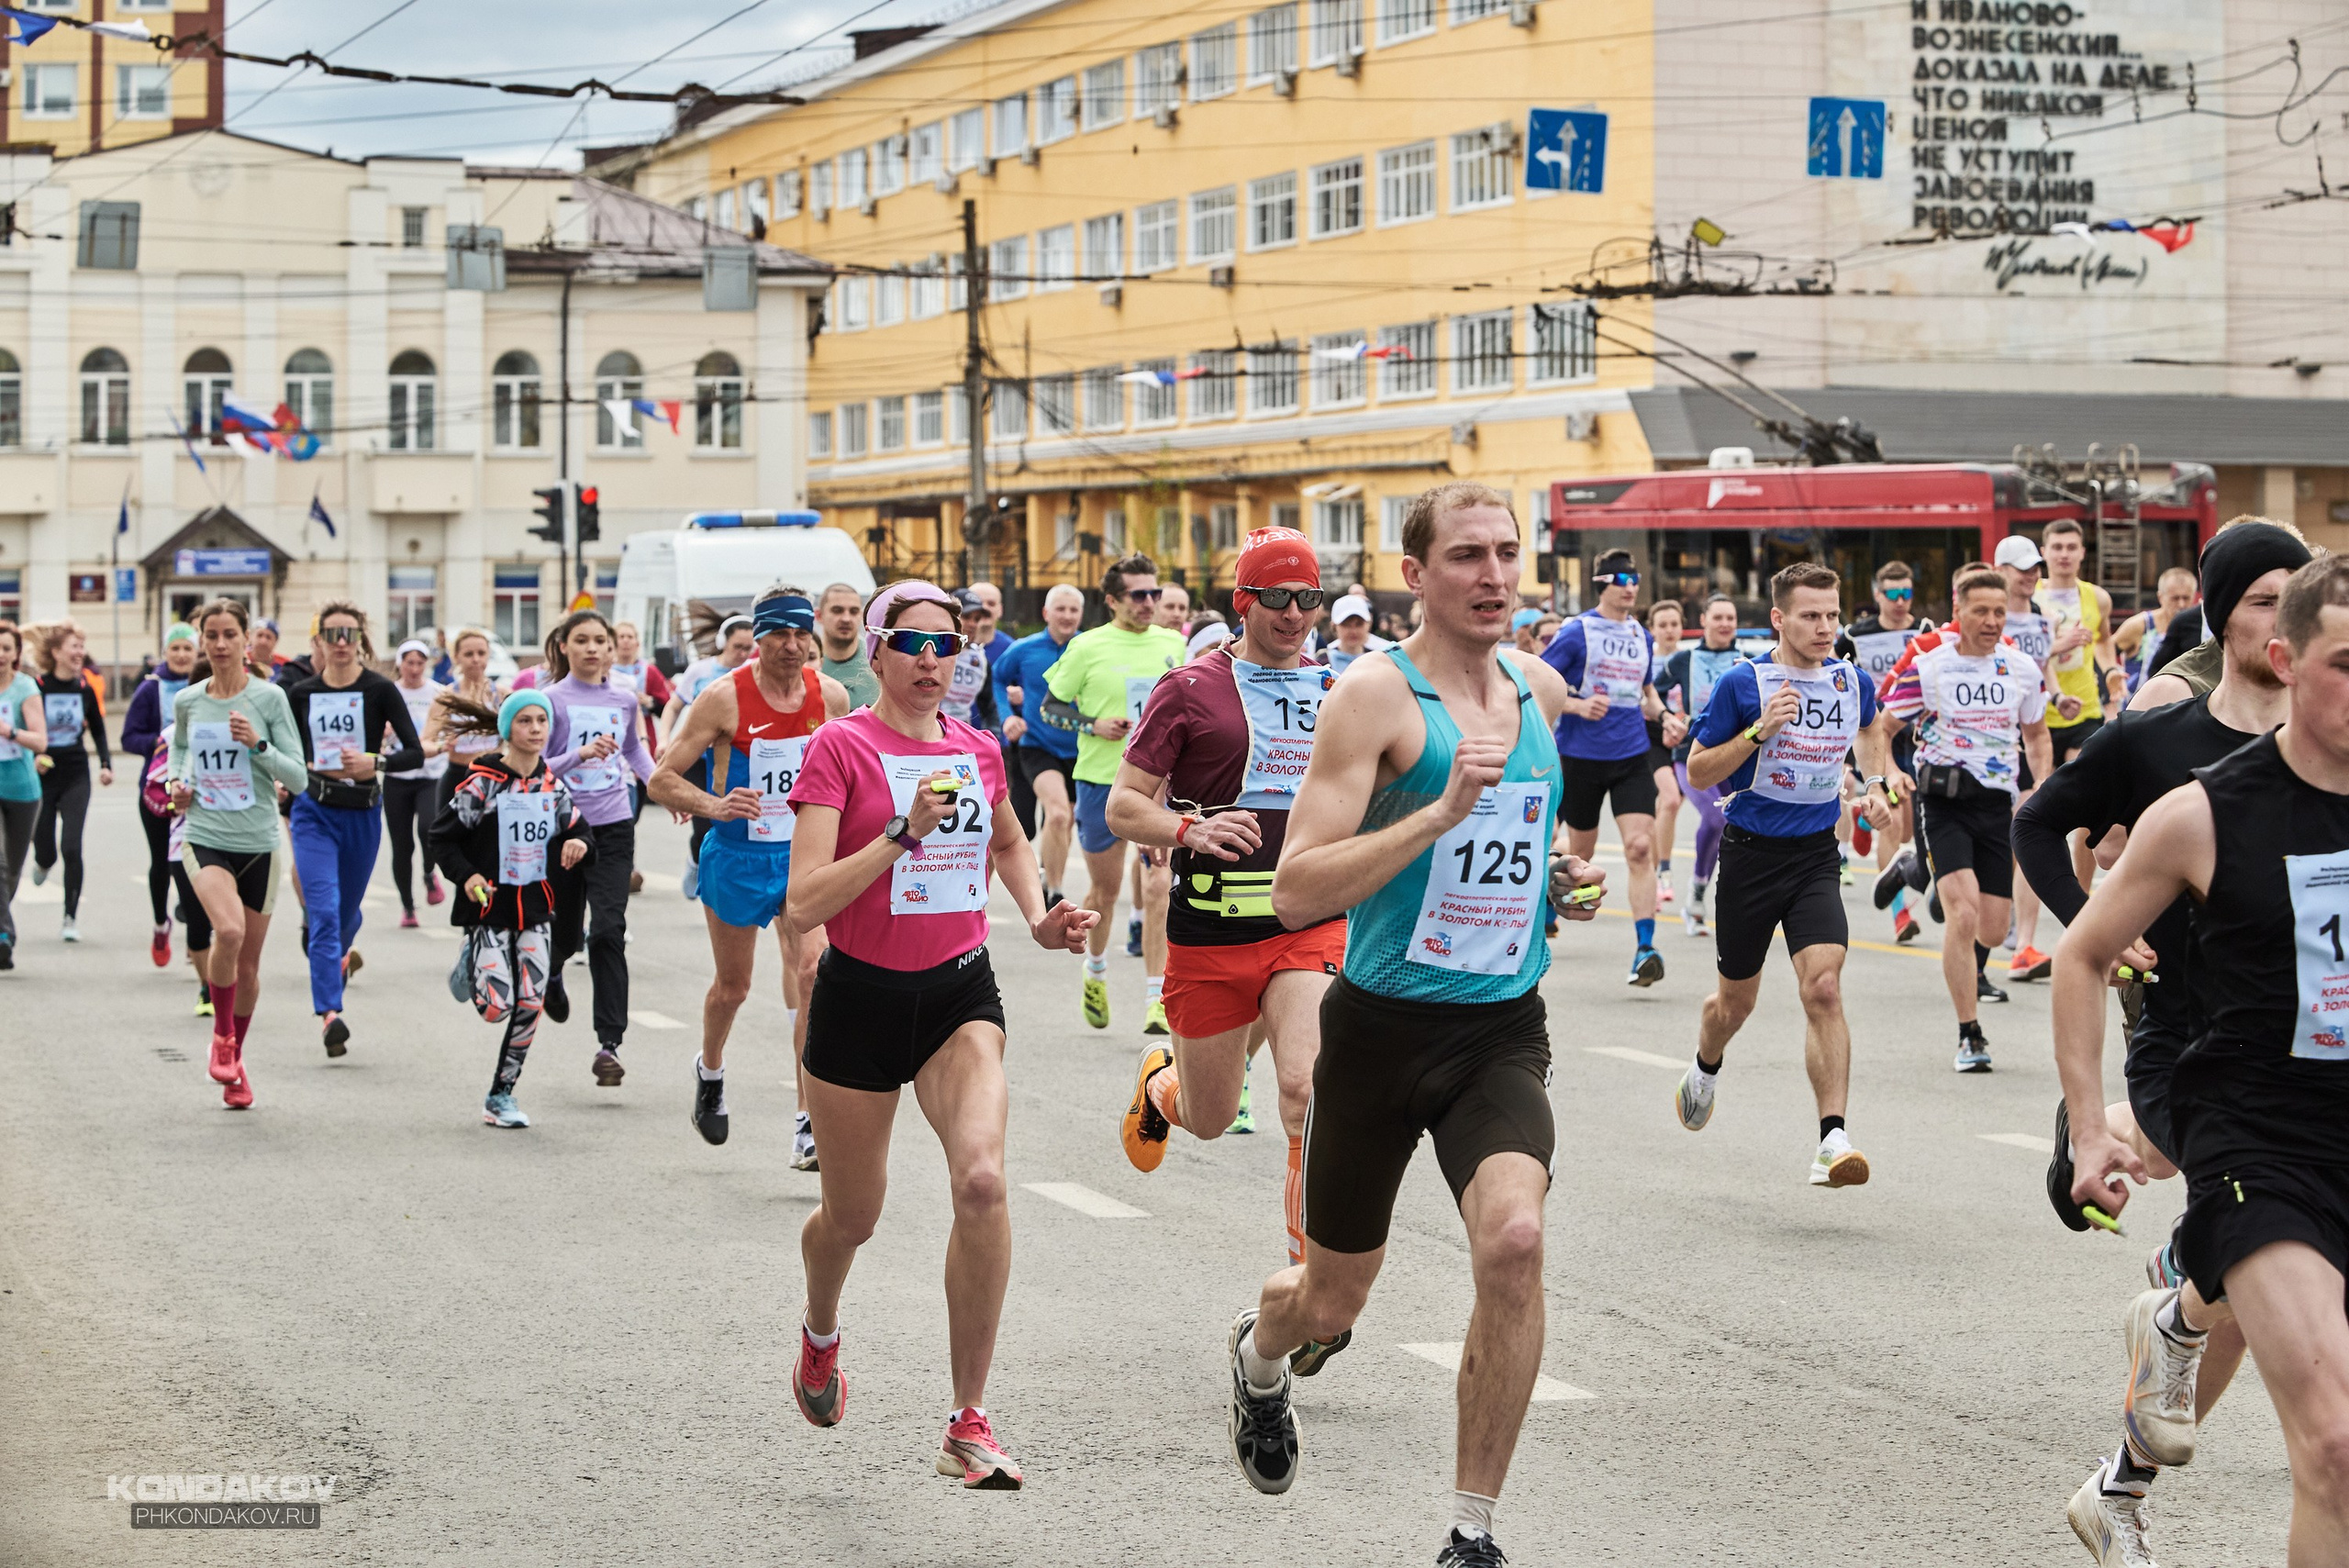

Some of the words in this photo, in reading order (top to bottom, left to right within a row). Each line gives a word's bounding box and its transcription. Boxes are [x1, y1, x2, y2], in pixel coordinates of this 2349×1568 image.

[1939, 0, 2085, 26] ИВАНОВО-
[1914, 57, 2039, 83] ДОКАЗАЛ
[2052, 61, 2087, 86] НА
[1912, 87, 1969, 111] ЧТО
[1912, 145, 1945, 170] НЕ
[1959, 148, 2075, 172] УСТУПИТ
[1914, 174, 2094, 203] ЗАВОЕВАНИЯ
[1872, 651, 1904, 673] 09
[1956, 682, 2005, 706] 040
[317, 714, 355, 732] 149
[1274, 696, 1323, 733] 15
[1766, 749, 1774, 758] В
[1776, 739, 1821, 752] КРАСНЫЙ
[198, 749, 239, 770] 117
[1255, 761, 1264, 772] В
[508, 819, 549, 842] 186
[909, 851, 954, 862] КАСНЫЙ
[954, 851, 977, 860] РУБИН
[1453, 840, 1532, 885] 125
[909, 863, 953, 873] ЗОЛОТОМ
[1440, 901, 1493, 915] КРАСНЫЙ
[1495, 906, 1527, 916] РУБИН
[1428, 910, 1435, 918] В
[1438, 912, 1491, 927] ЗОЛОТОМ
[1421, 937, 1443, 947] АВТО
[1425, 944, 1452, 956] РАДИО
[2311, 1003, 2319, 1013] В
